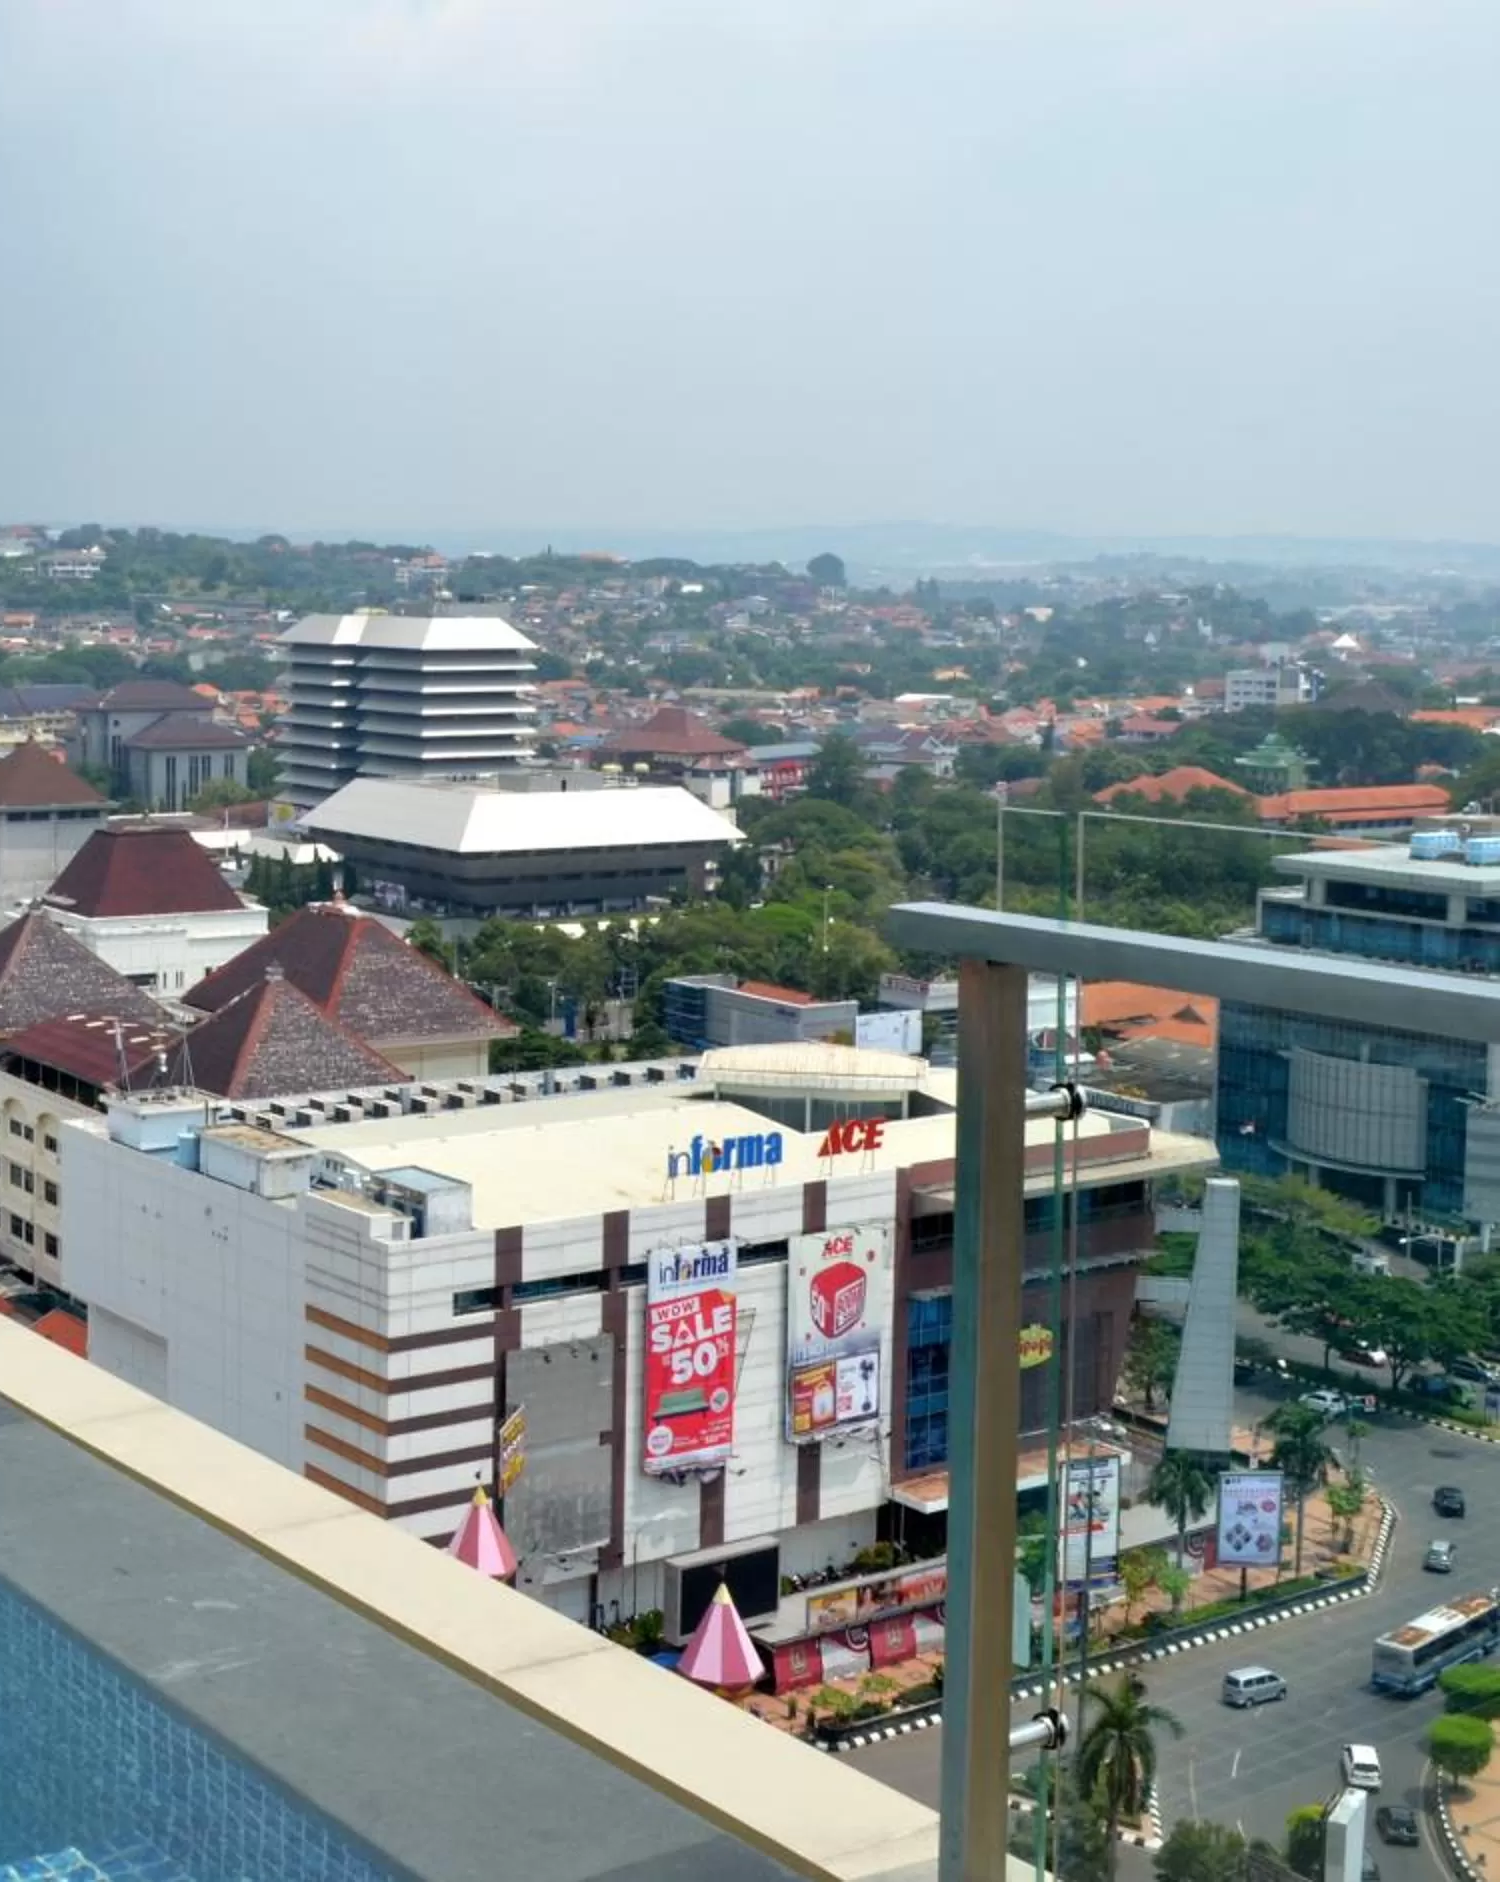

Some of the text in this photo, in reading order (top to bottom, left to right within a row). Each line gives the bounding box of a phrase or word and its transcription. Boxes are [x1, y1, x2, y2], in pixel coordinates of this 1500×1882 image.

[667, 1131, 783, 1179] informa
[818, 1118, 886, 1158] ACE
[822, 1235, 853, 1257] ACE
[659, 1250, 729, 1284] informa
[651, 1306, 732, 1351] SALE
[658, 1301, 696, 1320] WOW
